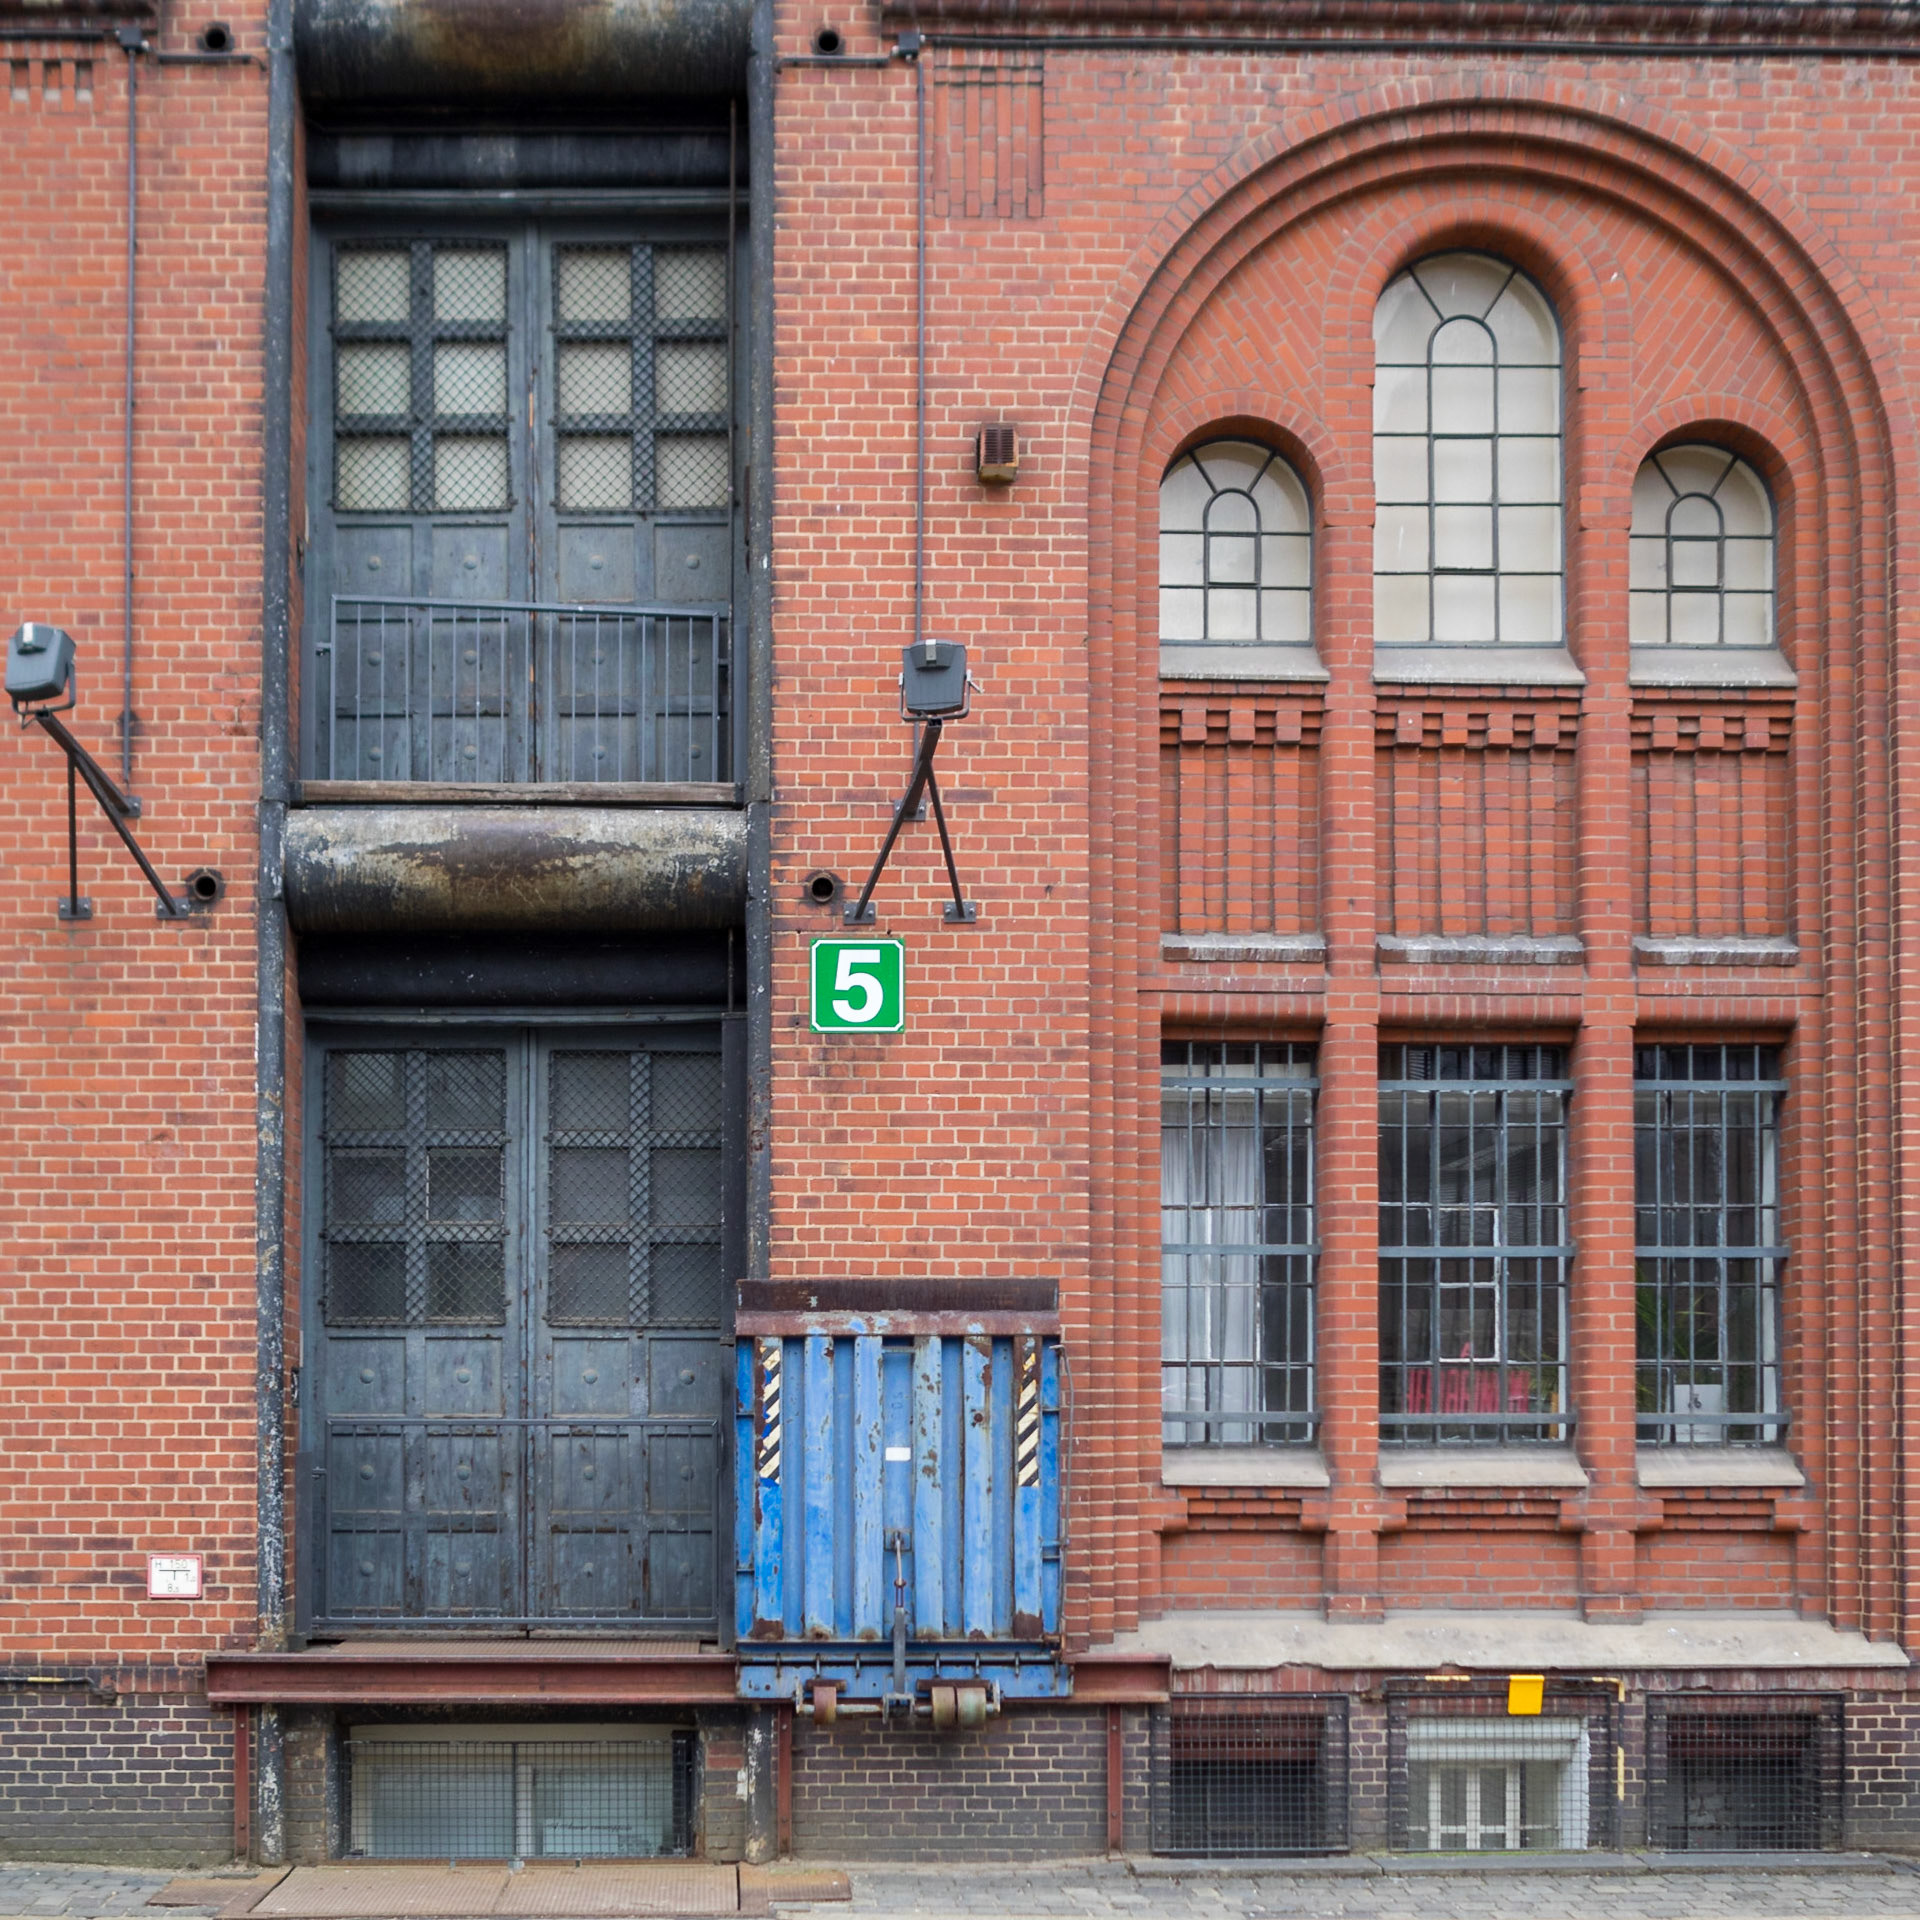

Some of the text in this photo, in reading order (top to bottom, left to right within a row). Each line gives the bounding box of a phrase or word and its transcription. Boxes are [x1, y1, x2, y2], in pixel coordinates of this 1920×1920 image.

[832, 949, 884, 1023] 5
[155, 1559, 162, 1568] H
[170, 1559, 188, 1568] 150
